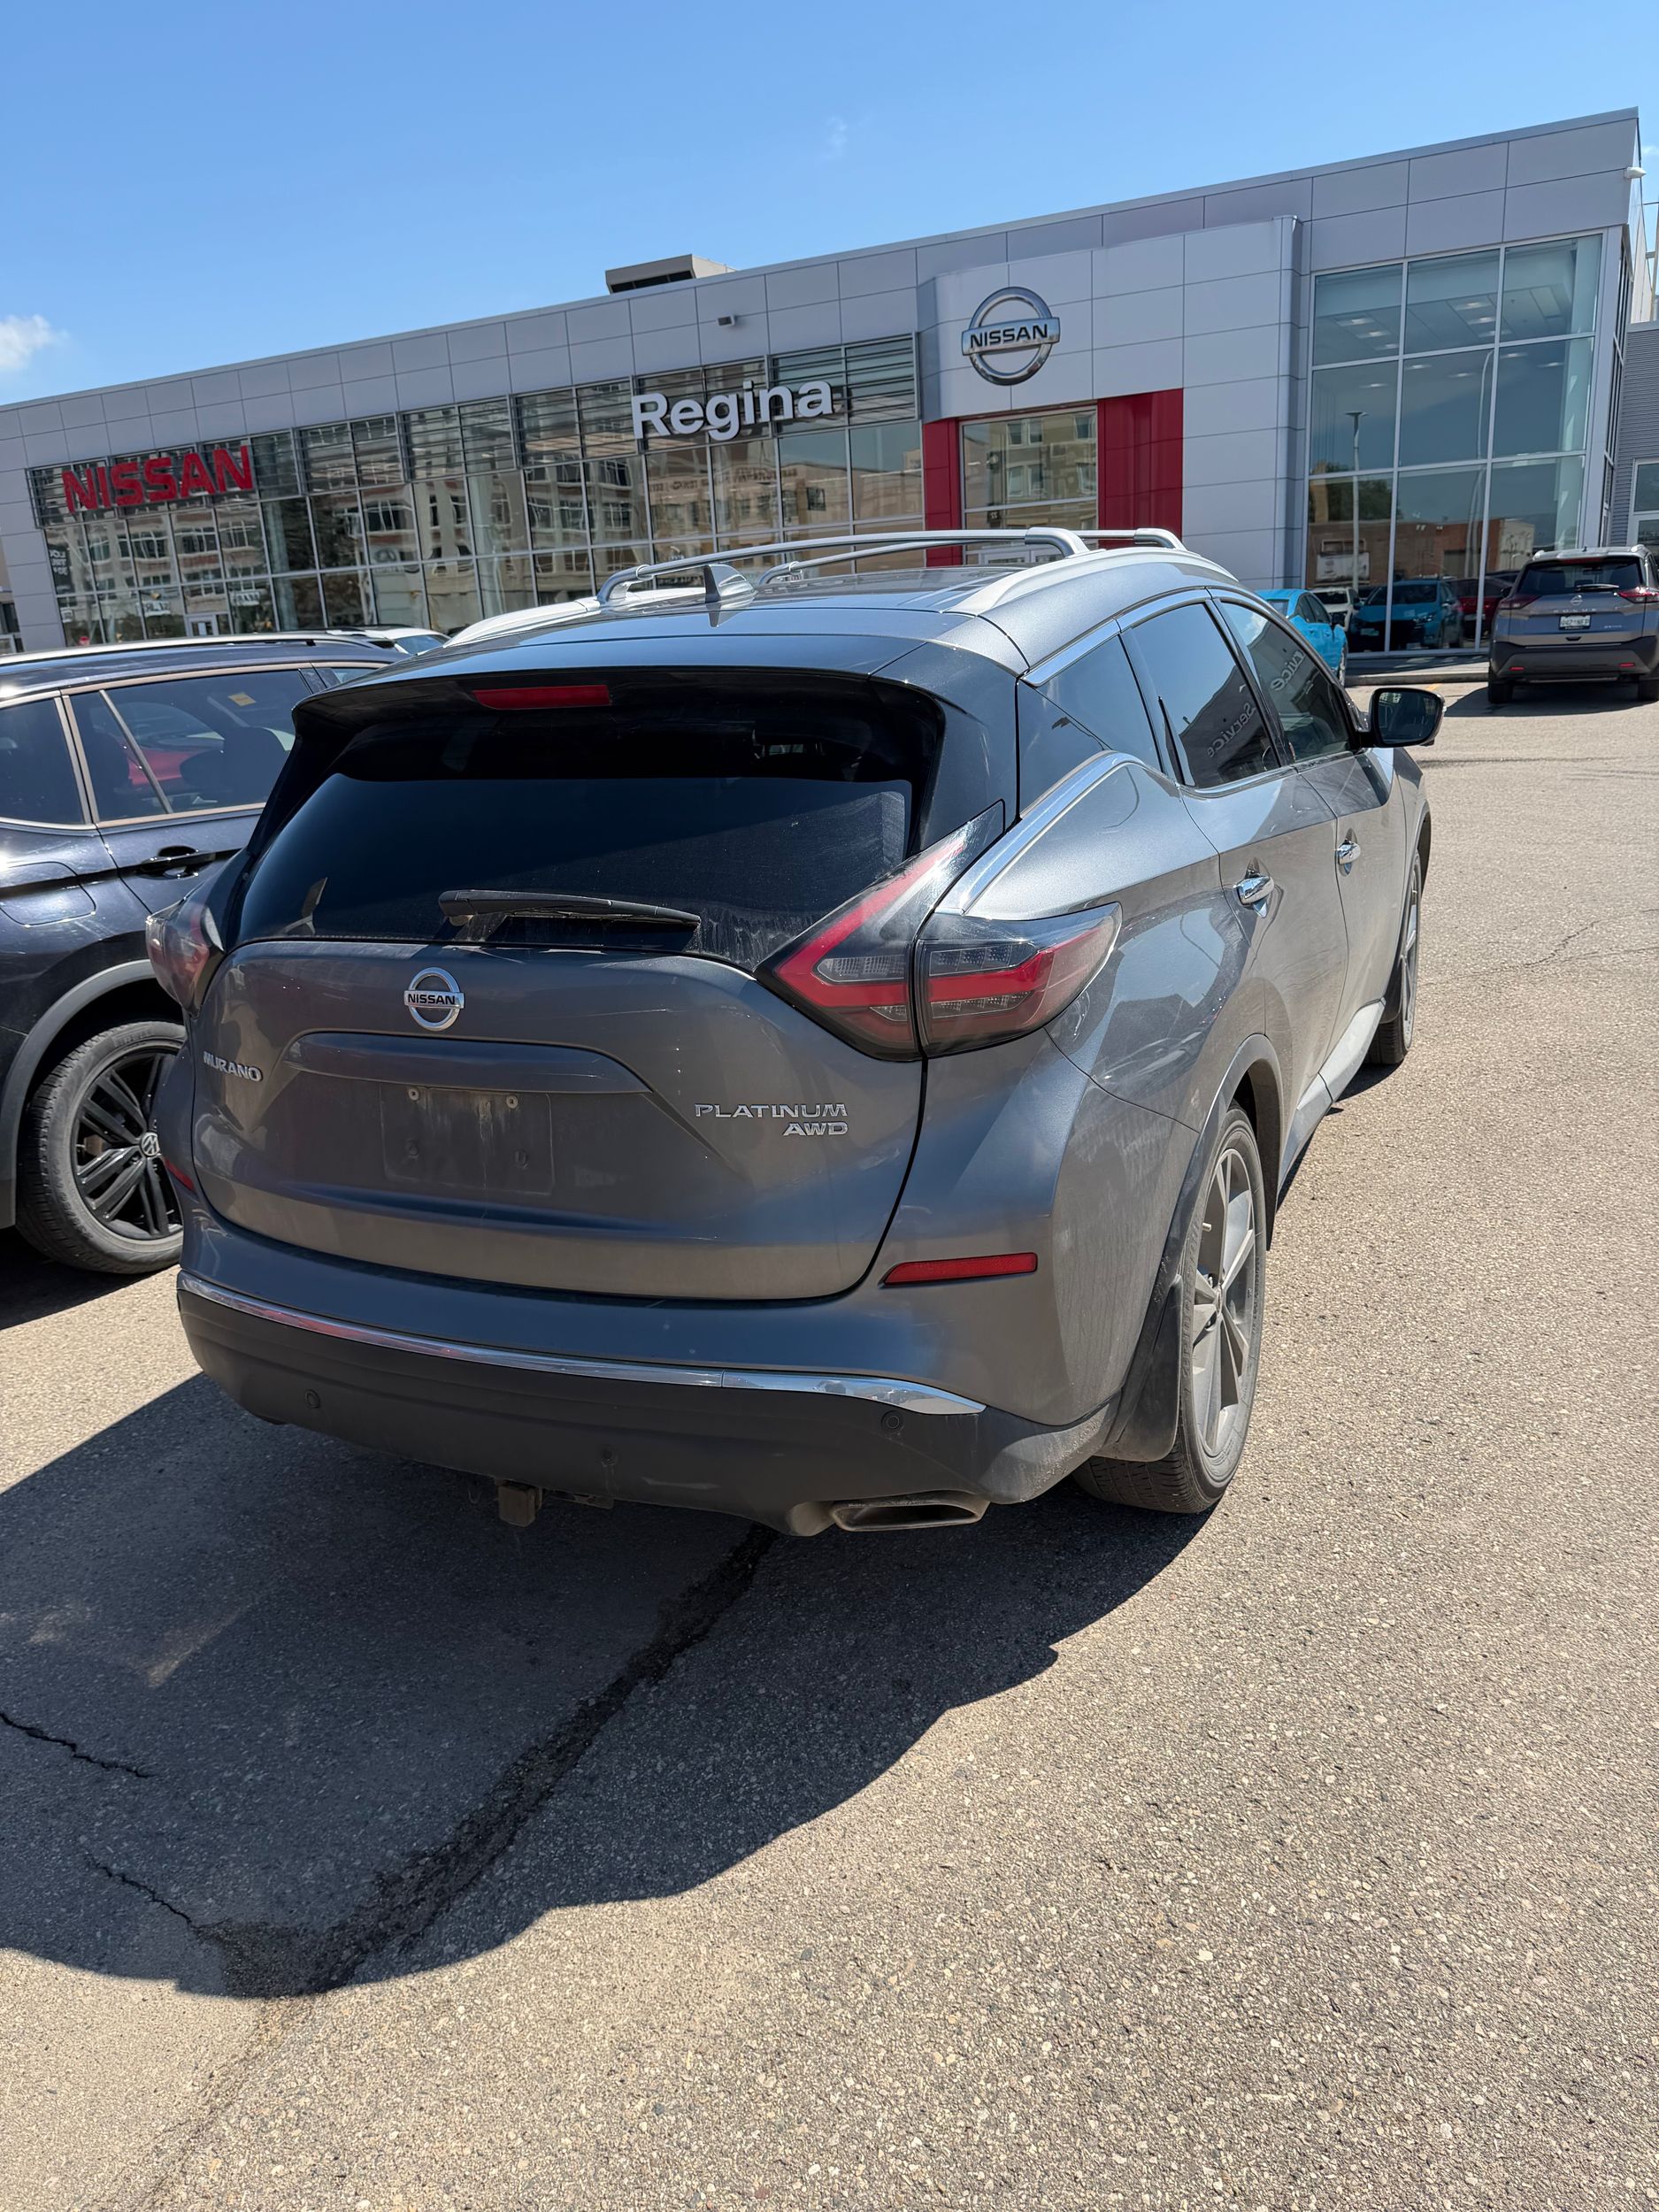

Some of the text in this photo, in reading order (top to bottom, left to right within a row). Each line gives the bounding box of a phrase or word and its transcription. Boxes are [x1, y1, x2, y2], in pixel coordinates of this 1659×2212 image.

[970, 324, 1048, 349] NISSAN
[632, 380, 833, 442] Regina
[63, 445, 254, 513] NISSAN
[407, 993, 456, 1005] NISSAN
[203, 1051, 263, 1082] MURANO
[694, 1103, 849, 1118] PLATINUM
[782, 1121, 849, 1136] AWD
